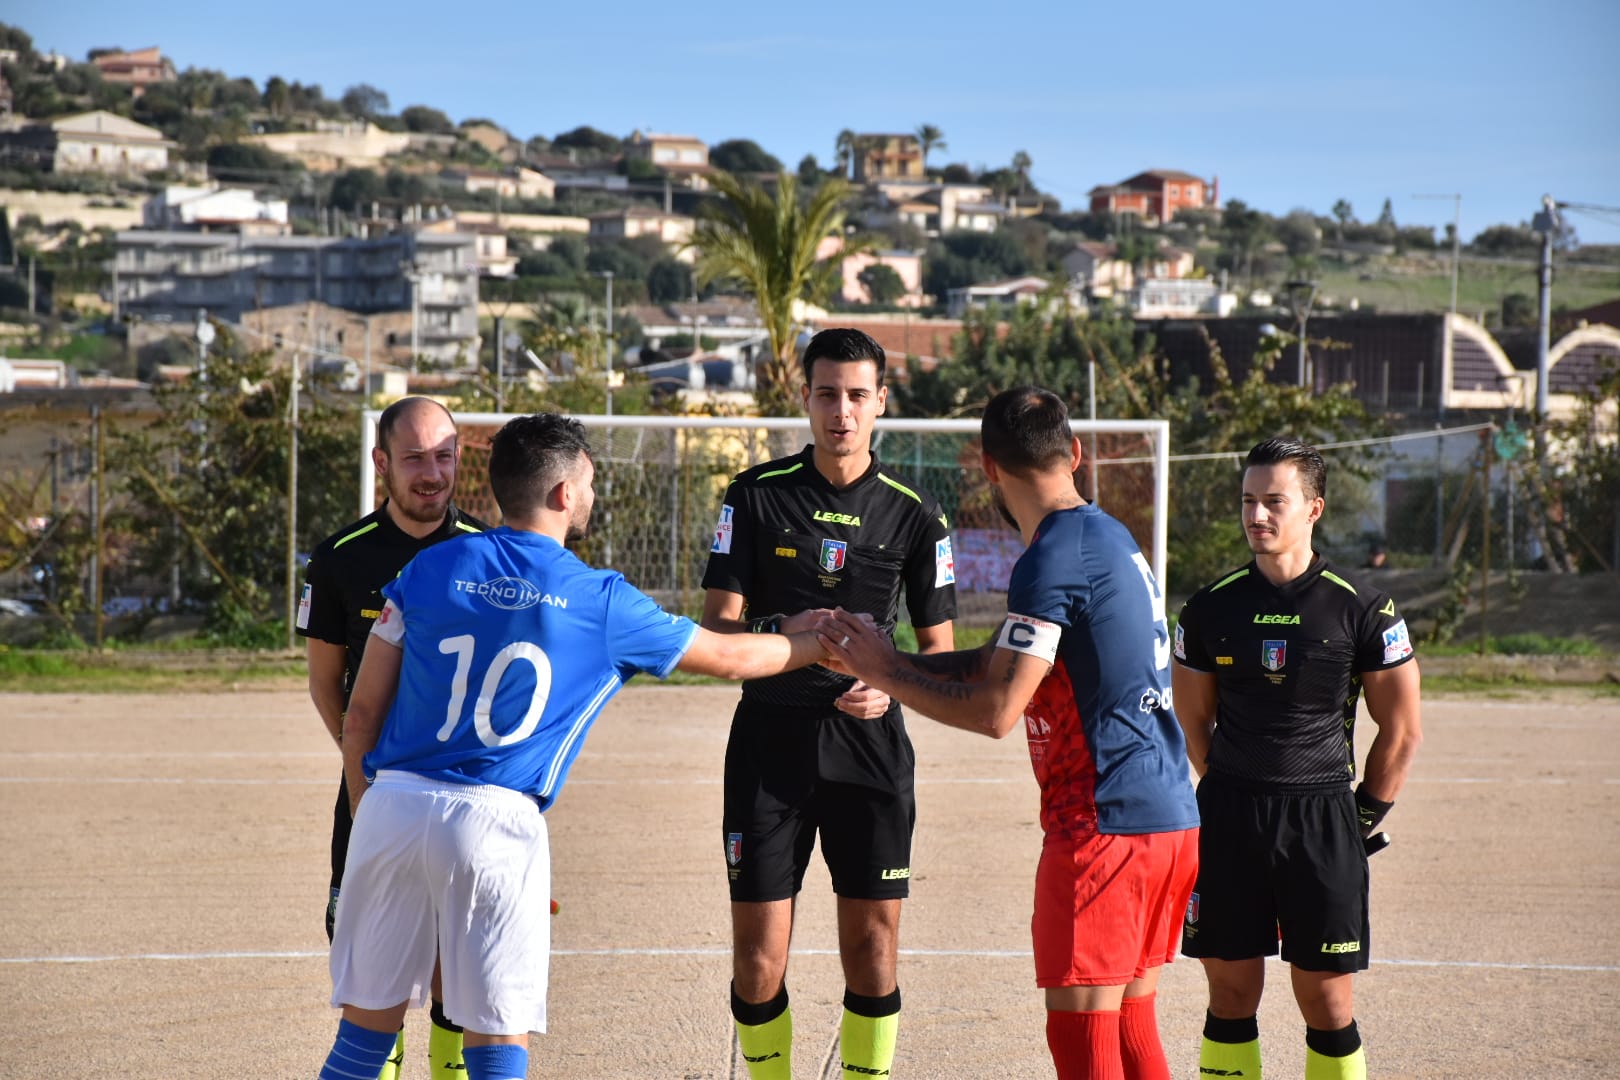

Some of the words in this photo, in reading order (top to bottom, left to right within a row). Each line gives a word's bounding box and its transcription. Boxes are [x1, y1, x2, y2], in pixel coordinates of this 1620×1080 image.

[813, 510, 861, 527] LEGEA
[1253, 614, 1301, 625] LEGEA
[1008, 623, 1036, 648] C
[436, 634, 552, 748] 10
[881, 867, 911, 880] LEGE
